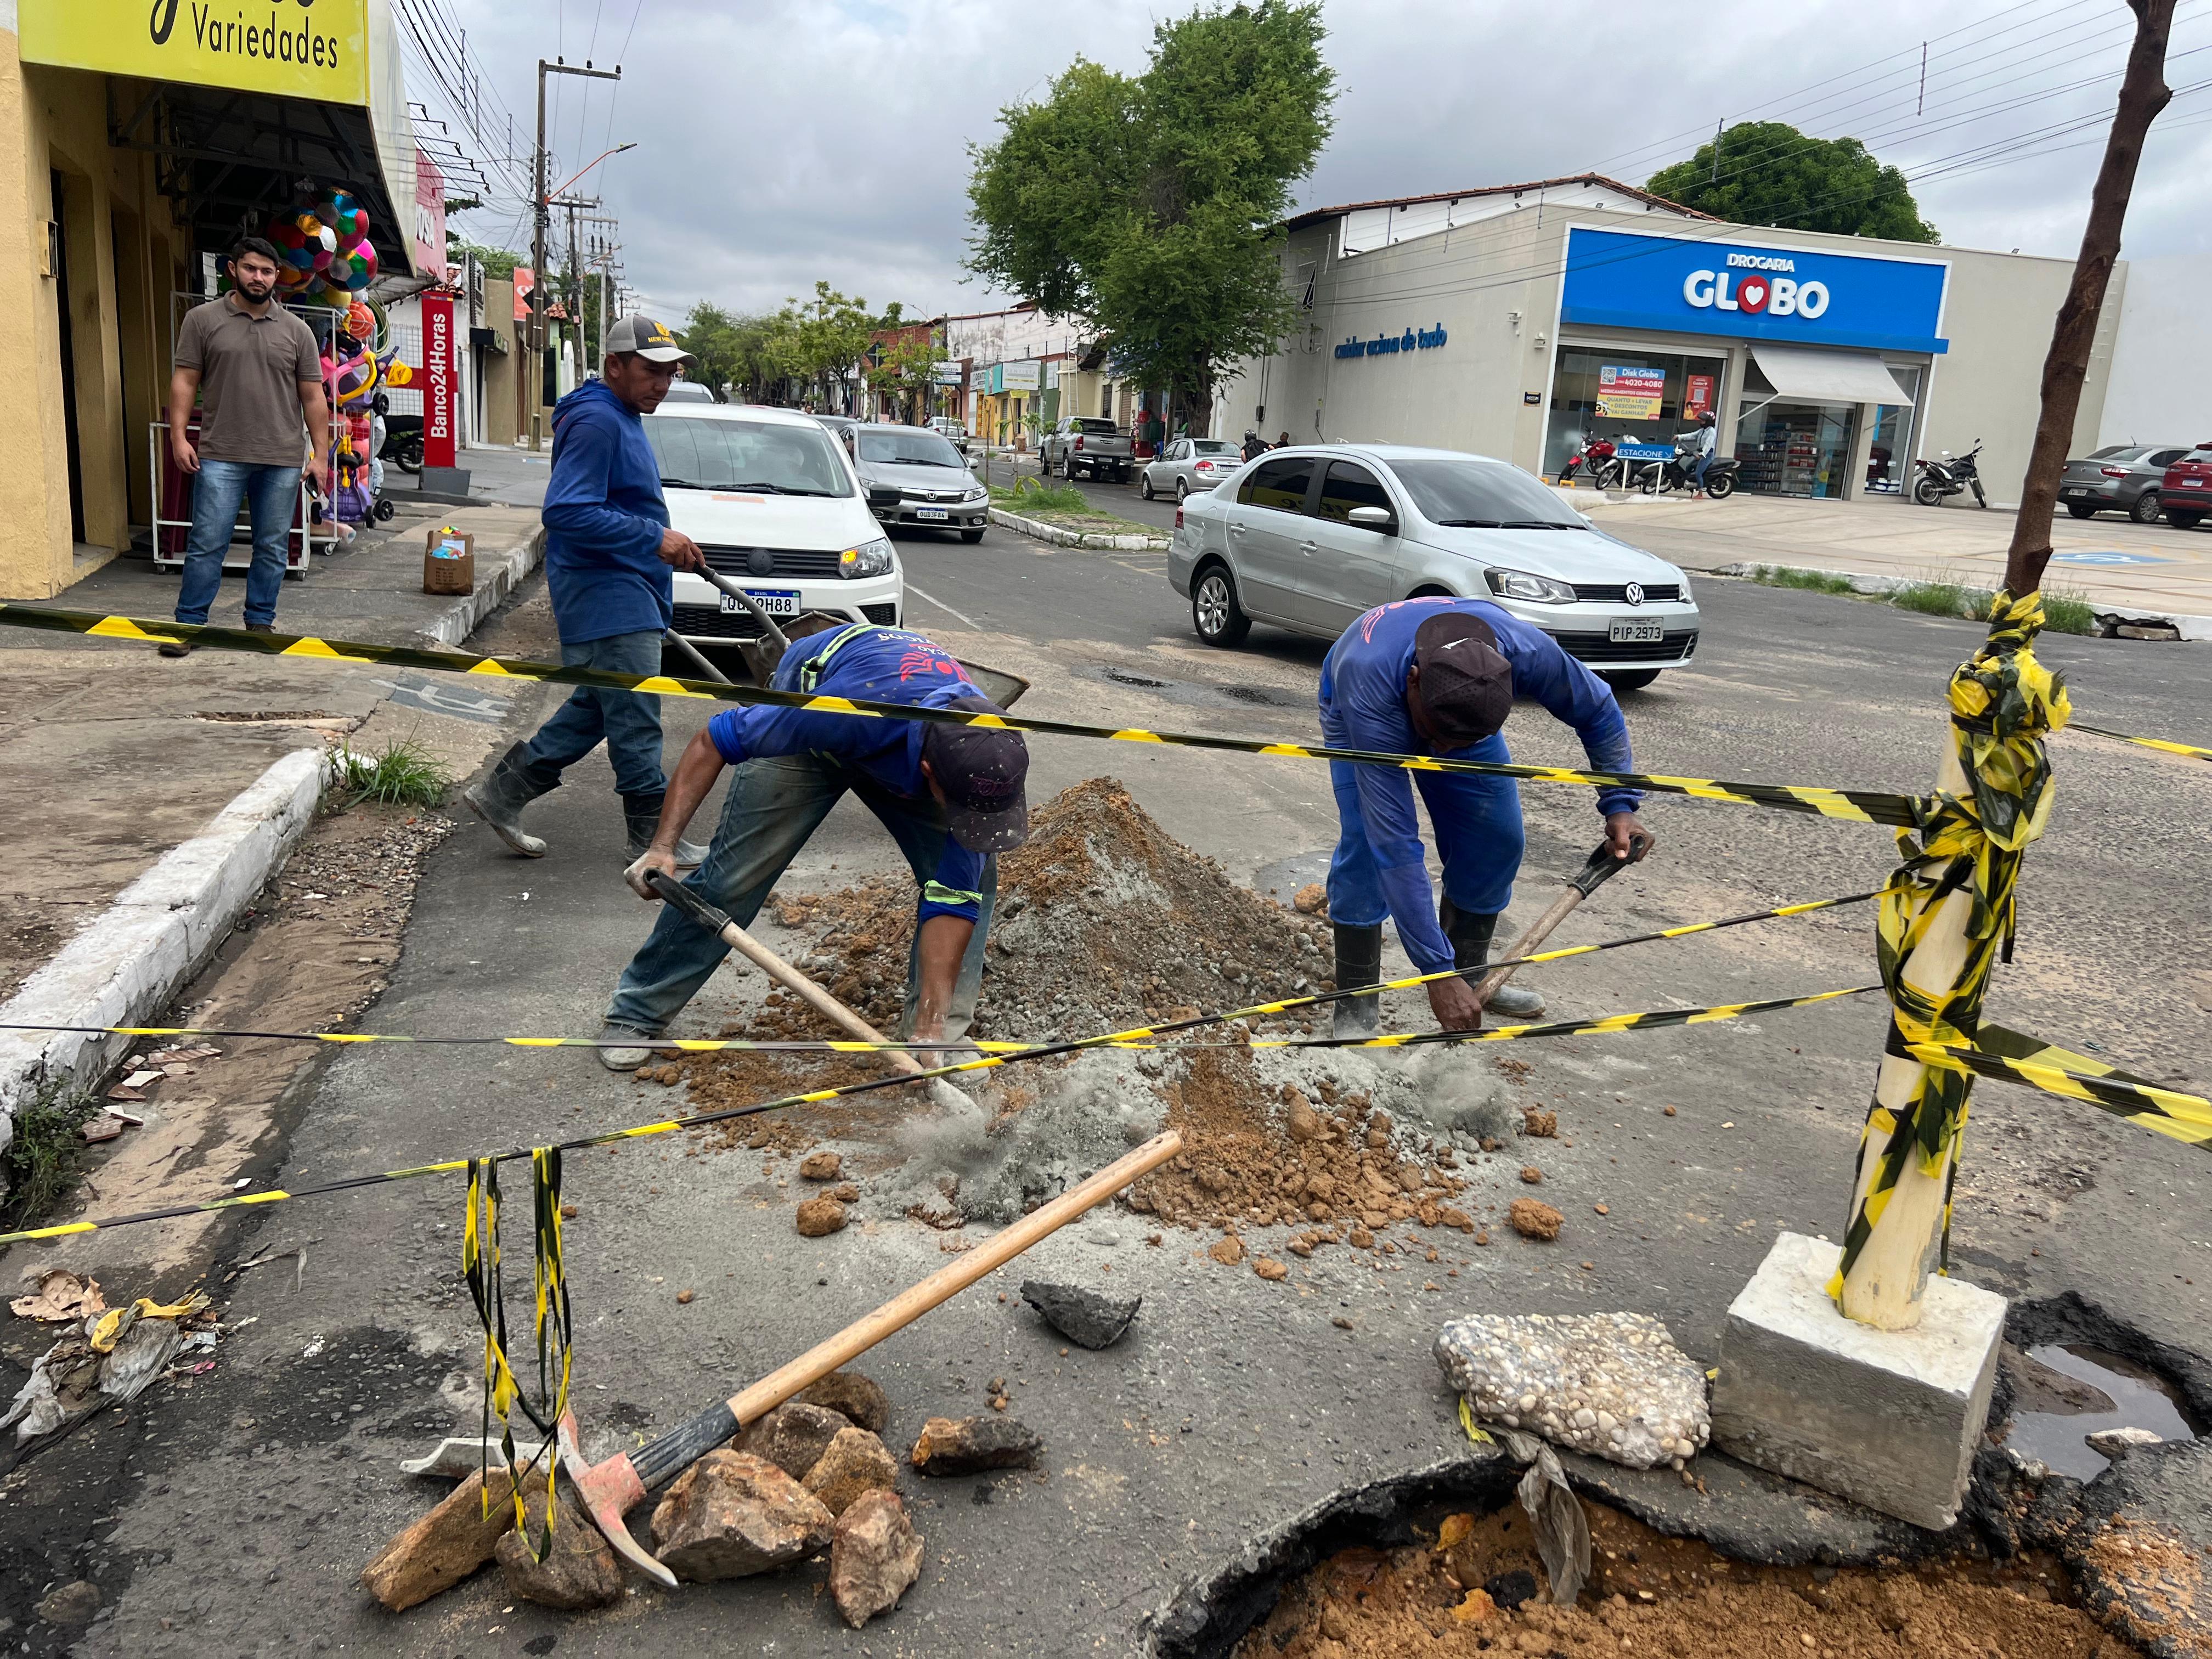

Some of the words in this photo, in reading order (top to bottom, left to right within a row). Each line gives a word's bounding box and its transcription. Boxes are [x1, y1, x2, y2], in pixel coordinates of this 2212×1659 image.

[192, 2, 337, 69] Variedades
[416, 202, 435, 249] OSA
[1726, 253, 1795, 272] DROGARIA
[1683, 269, 1830, 319] GLOBO
[1367, 333, 1400, 356] acima
[1401, 327, 1417, 351] de
[1418, 322, 1448, 349] tudo
[430, 313, 447, 438] Banco24Horas
[1624, 379, 1662, 387] 4020-4080
[1639, 370, 1659, 378] Globo
[1619, 449, 1663, 458] ESTACIONE
